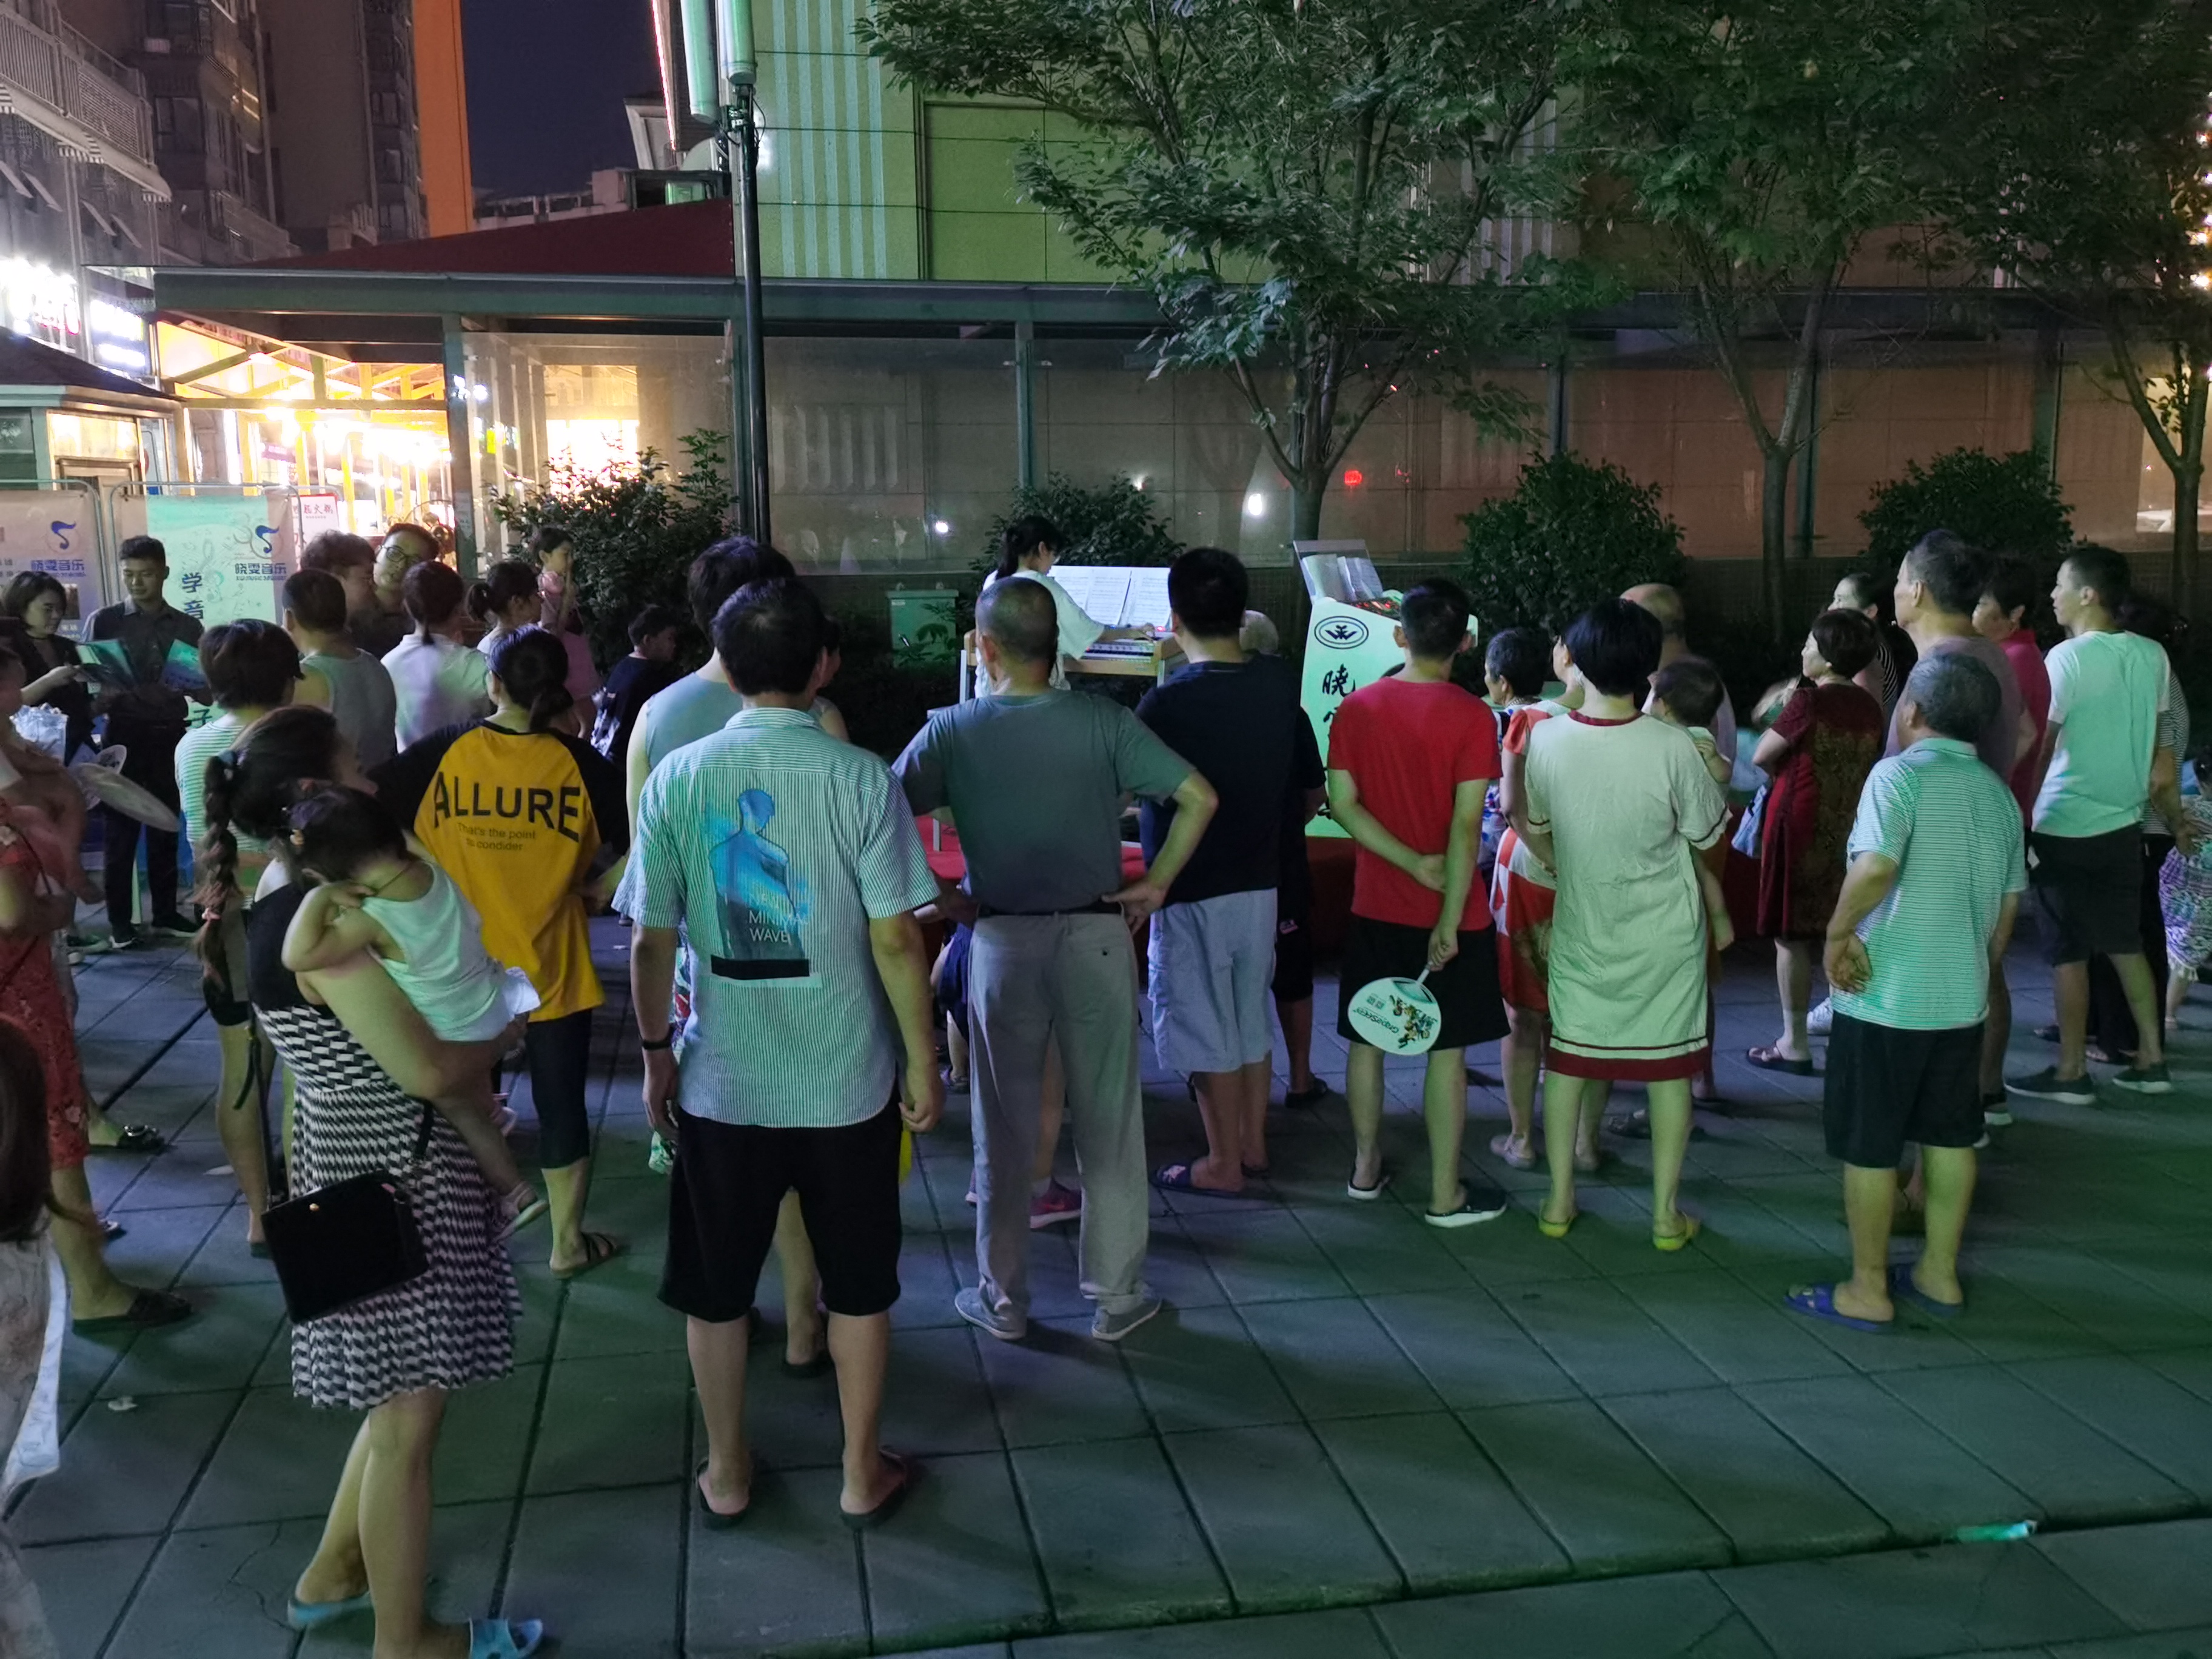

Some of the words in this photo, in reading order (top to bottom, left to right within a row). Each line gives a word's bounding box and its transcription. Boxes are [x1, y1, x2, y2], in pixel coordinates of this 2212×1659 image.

[235, 563, 287, 574] 晓雯音乐
[434, 771, 581, 843] ALLURE
[489, 827, 506, 837] the
[508, 830, 536, 840] point
[749, 927, 788, 943] WAVE
